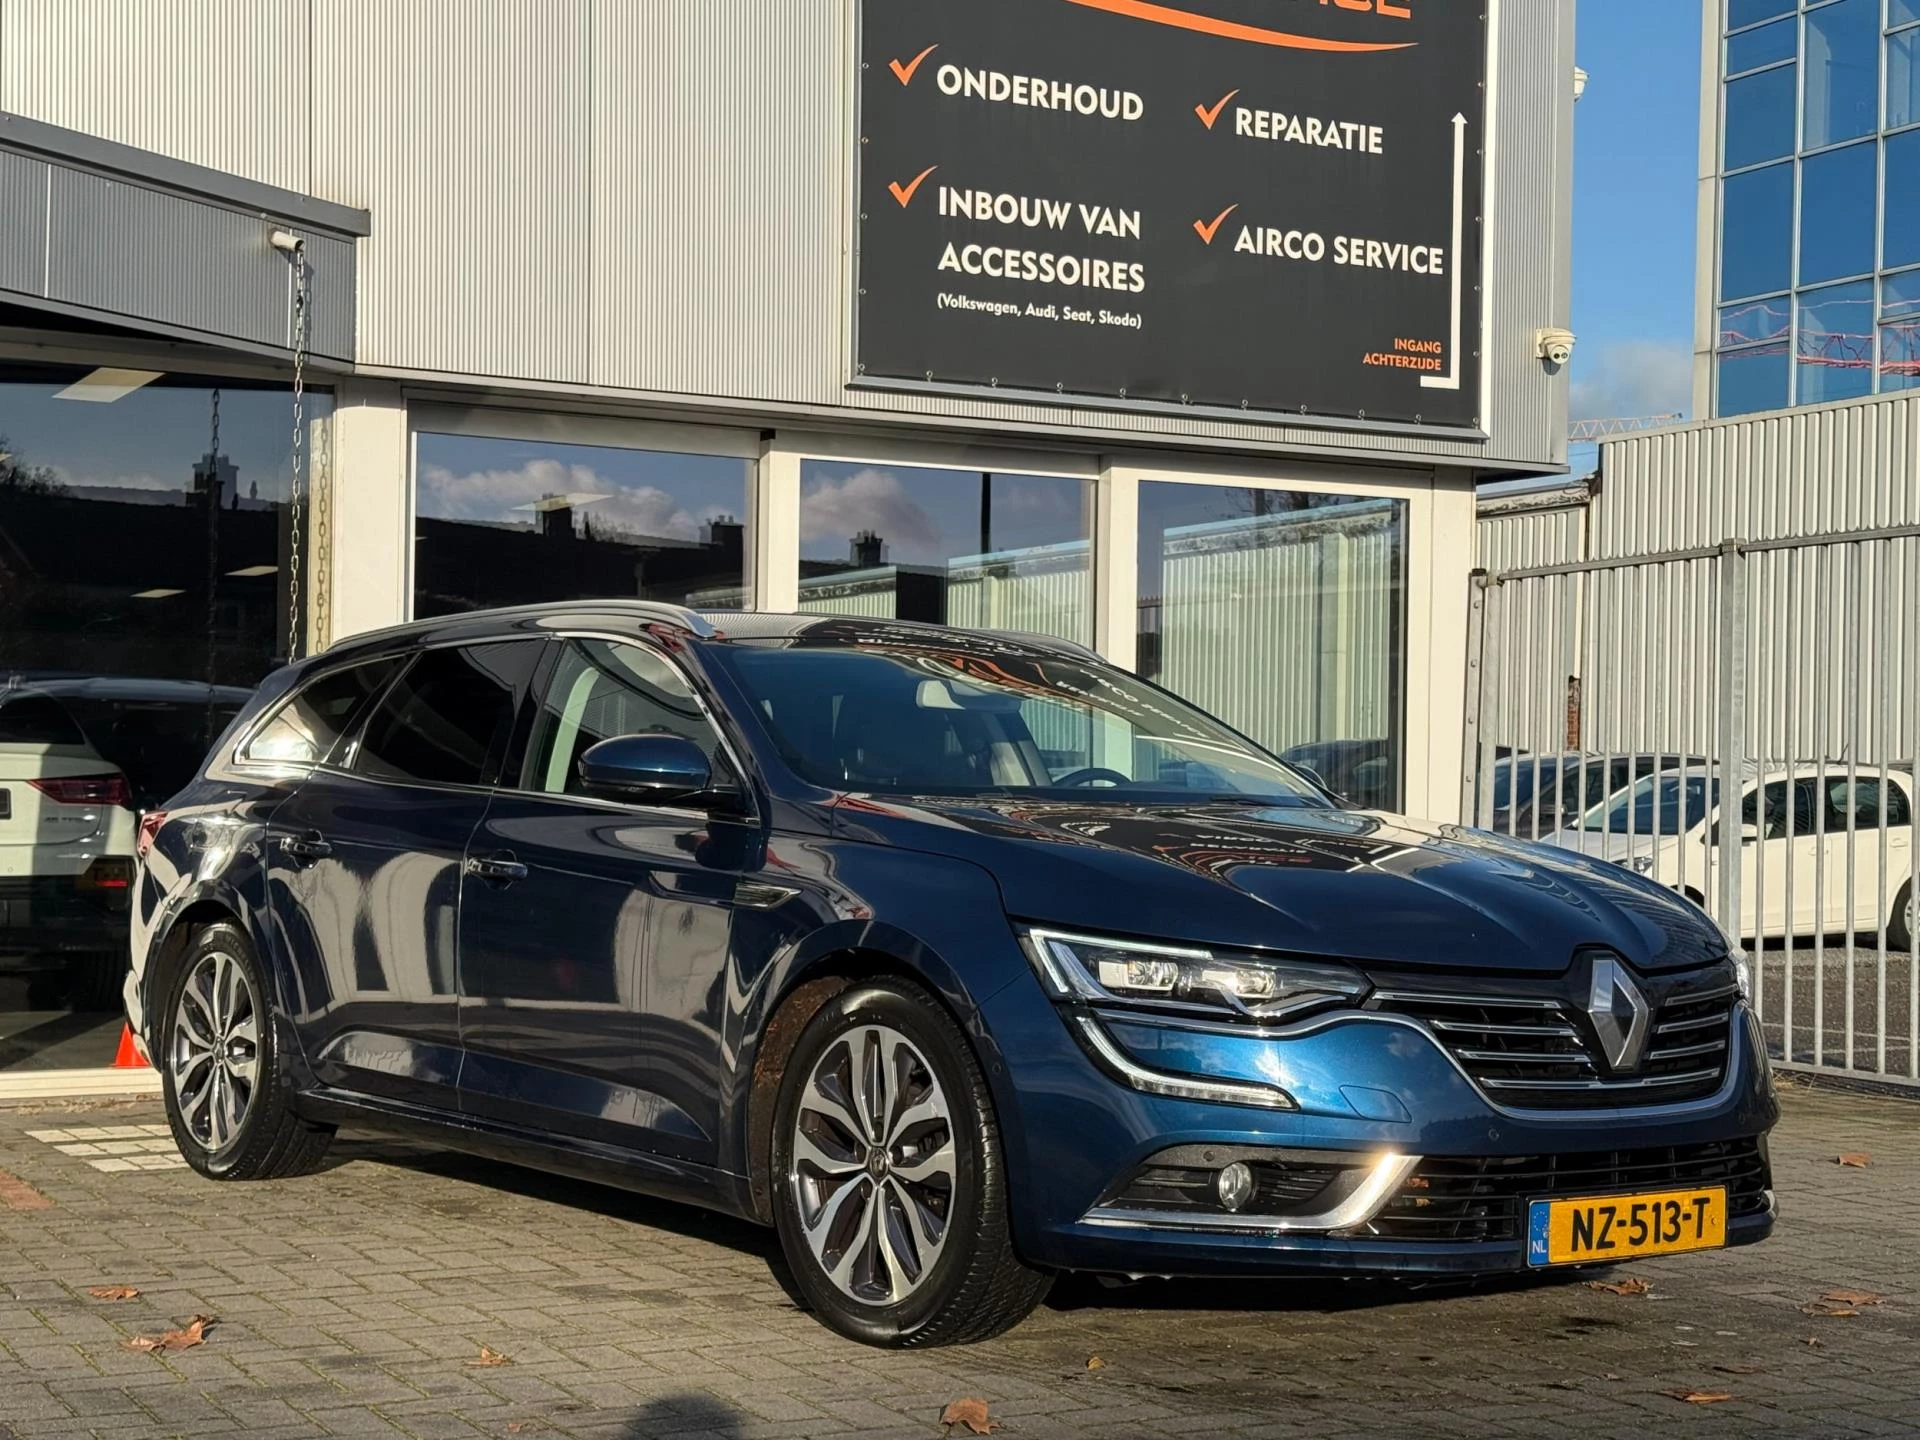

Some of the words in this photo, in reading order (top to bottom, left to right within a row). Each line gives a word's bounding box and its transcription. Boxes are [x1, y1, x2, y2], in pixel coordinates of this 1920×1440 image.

[937, 64, 1144, 121] ONDERHOUD
[1235, 107, 1384, 155] REPARATIE
[938, 186, 1072, 231] INBOUW
[1078, 203, 1141, 240] VAN
[937, 241, 1146, 293] ACCESSOIRES
[1233, 224, 1325, 262] AIRCO
[1333, 235, 1444, 275] SERVICE
[936, 292, 1022, 317] (Volkswagen,
[1024, 302, 1060, 321] Audi,
[1062, 305, 1096, 325] Seat,
[1098, 309, 1143, 330] Skoda)
[1362, 352, 1442, 371] ACHTERZIJDE
[1393, 337, 1442, 354] INGANG
[1532, 1239, 1547, 1254] NL
[1570, 1197, 1711, 1252] NZ-513-T
